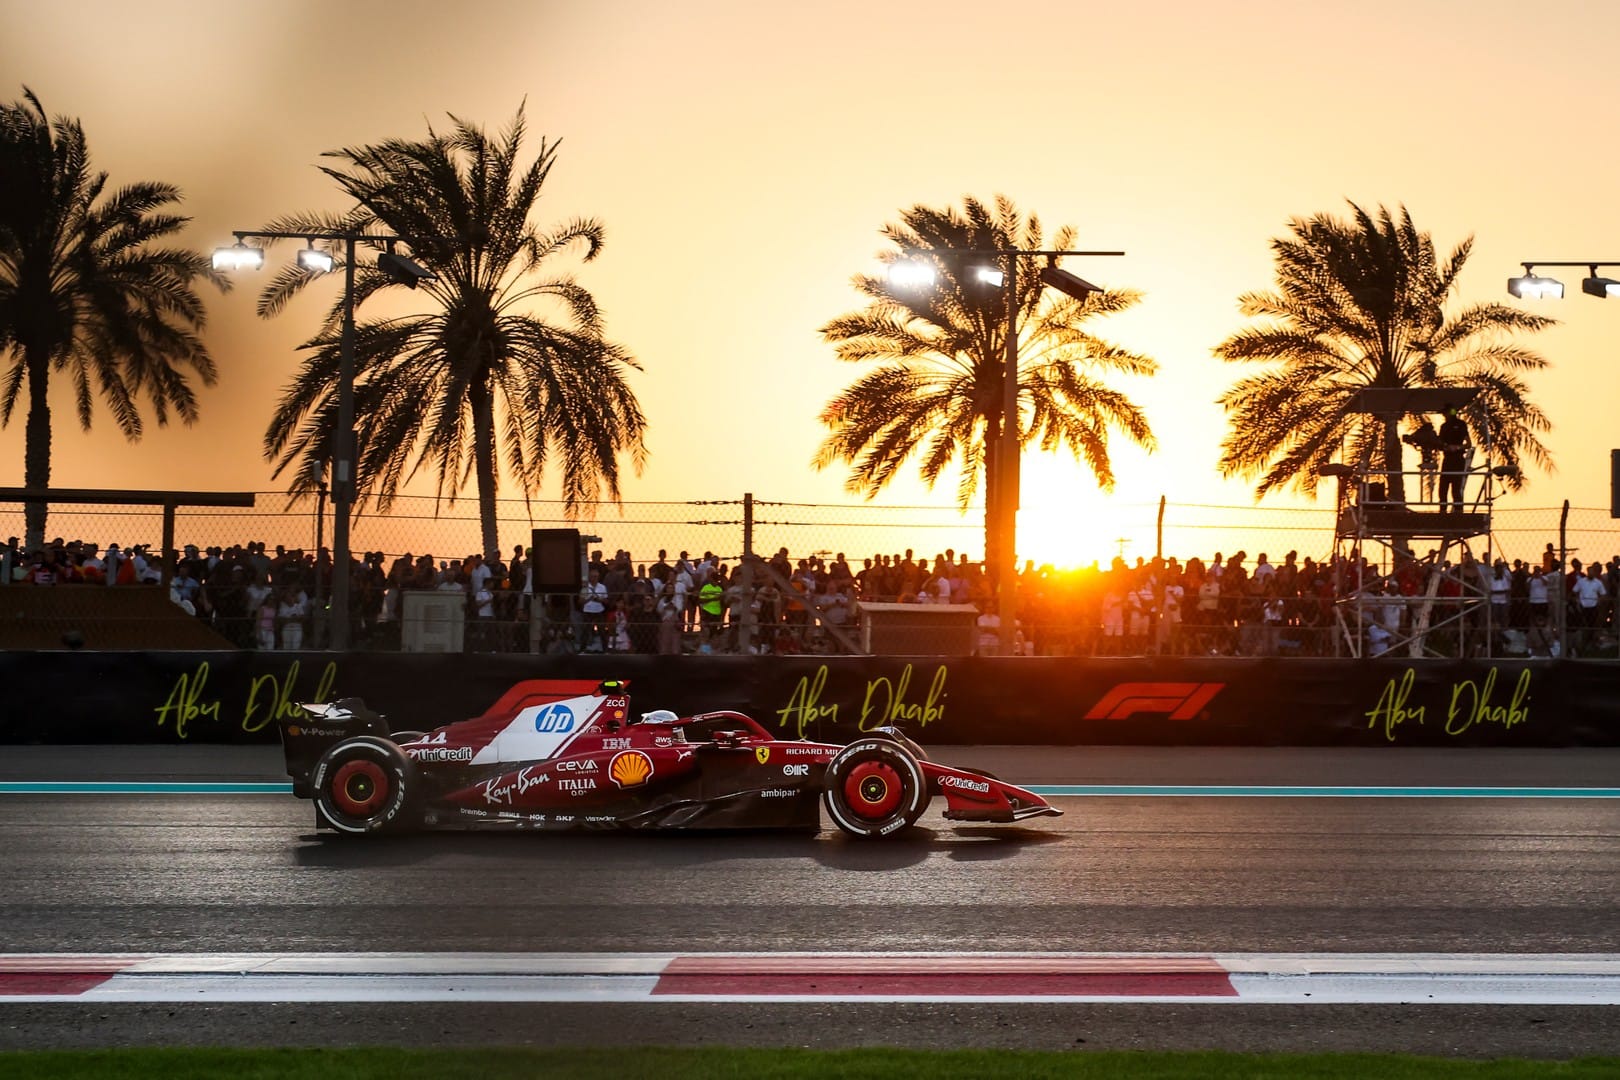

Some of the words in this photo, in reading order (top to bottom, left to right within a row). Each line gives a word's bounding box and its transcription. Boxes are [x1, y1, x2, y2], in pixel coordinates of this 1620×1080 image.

[154, 661, 220, 739] Abu
[606, 699, 625, 707] ZCG
[776, 665, 839, 739] Abu
[858, 664, 948, 732] Dhabi
[1083, 682, 1226, 720] F1
[1365, 668, 1425, 741] Abu
[1445, 667, 1531, 735] Dhabi
[538, 705, 572, 733] hp
[301, 727, 346, 736] V-Power
[602, 738, 631, 750] IBM
[655, 736, 672, 745] aws
[419, 748, 472, 761] UniCredit
[558, 779, 597, 790] ITALIA
[955, 778, 989, 792] UniCredit
[761, 789, 796, 798] ambipar
[460, 807, 487, 817] brembo
